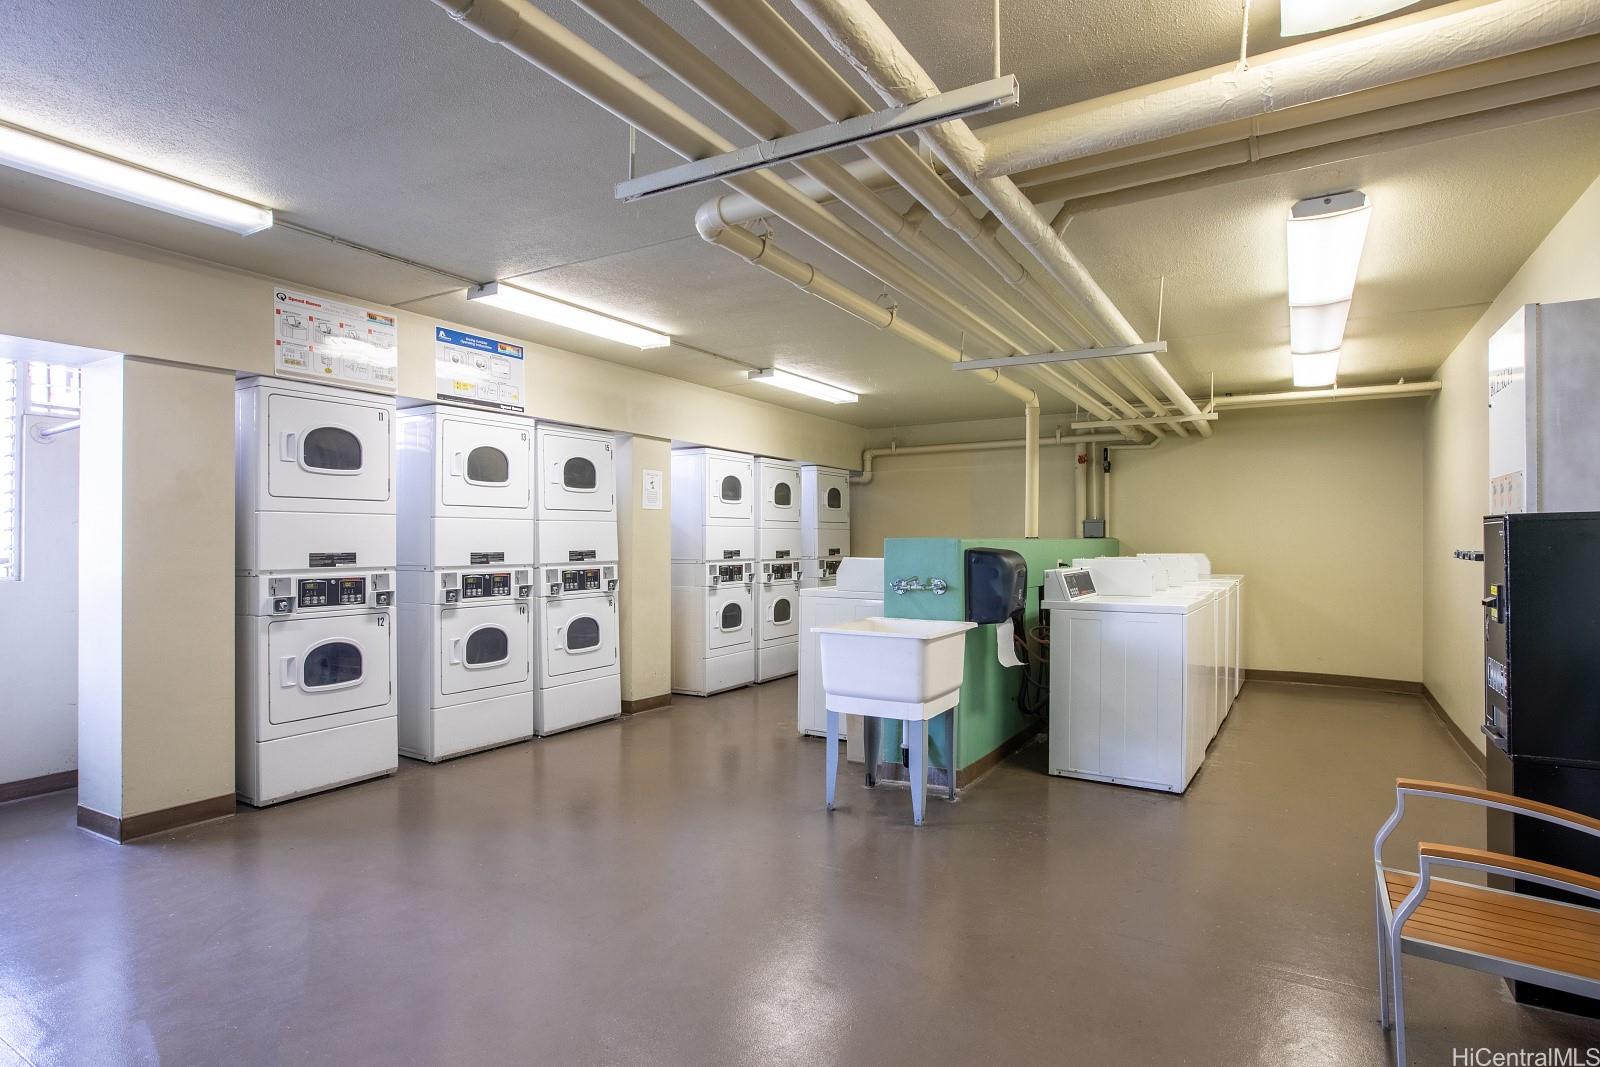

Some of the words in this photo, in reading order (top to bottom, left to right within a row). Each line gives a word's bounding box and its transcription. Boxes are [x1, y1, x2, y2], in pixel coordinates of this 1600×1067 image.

[288, 296, 304, 304] Speed
[305, 300, 321, 308] Queen
[378, 411, 384, 421] 11
[519, 606, 525, 616] 14
[377, 616, 385, 627] 12
